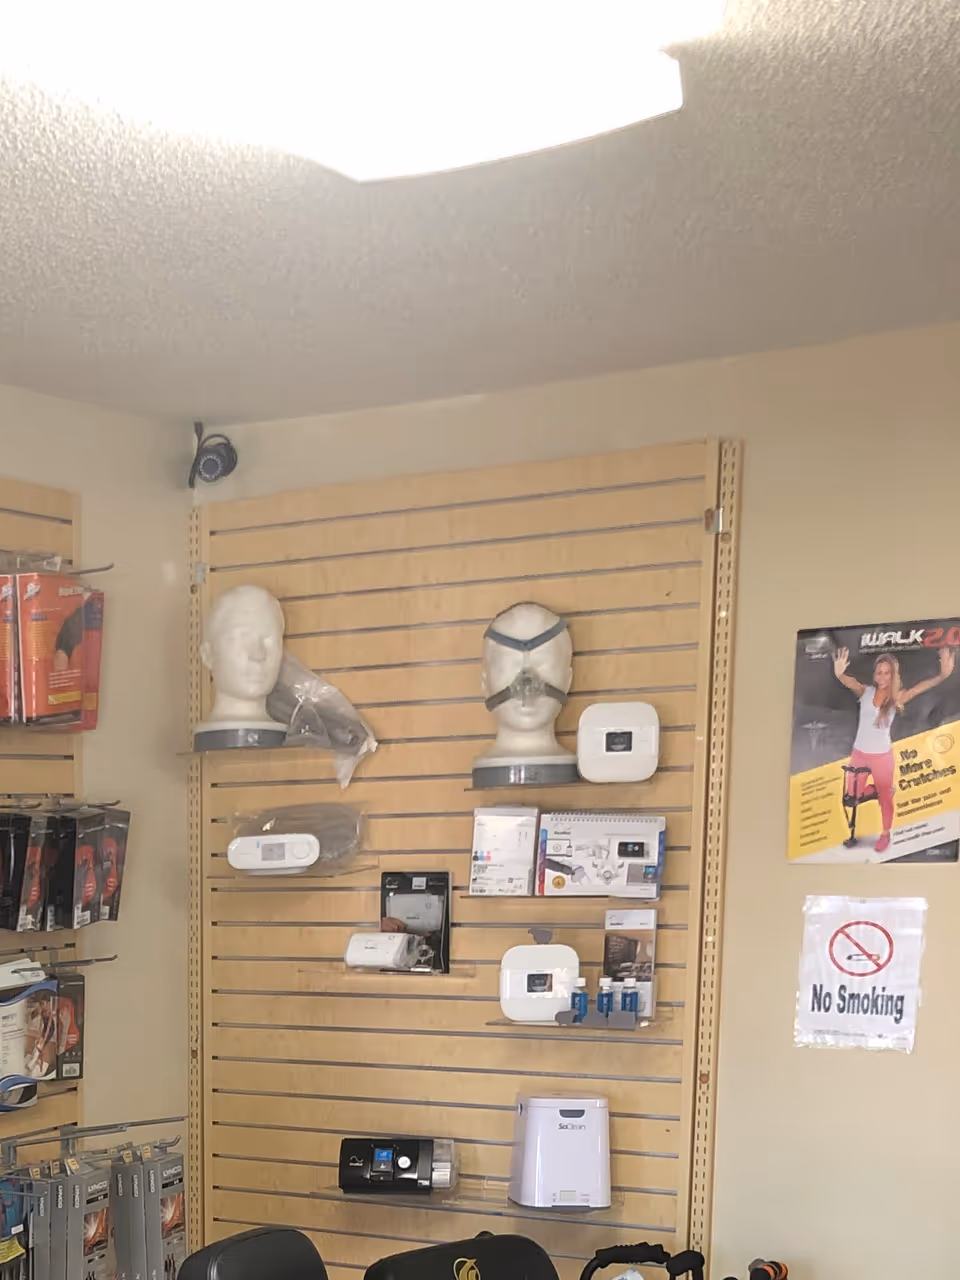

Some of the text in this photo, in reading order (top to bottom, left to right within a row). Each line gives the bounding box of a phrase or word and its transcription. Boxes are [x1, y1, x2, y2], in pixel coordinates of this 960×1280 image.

[899, 749, 918, 762] No
[899, 758, 933, 777] More
[898, 765, 957, 792] Crutches
[811, 983, 905, 1025] No Smoking
[558, 1122, 586, 1131] SoClean
[162, 1165, 183, 1178] LYNCO
[88, 1180, 108, 1193] LYNCO
